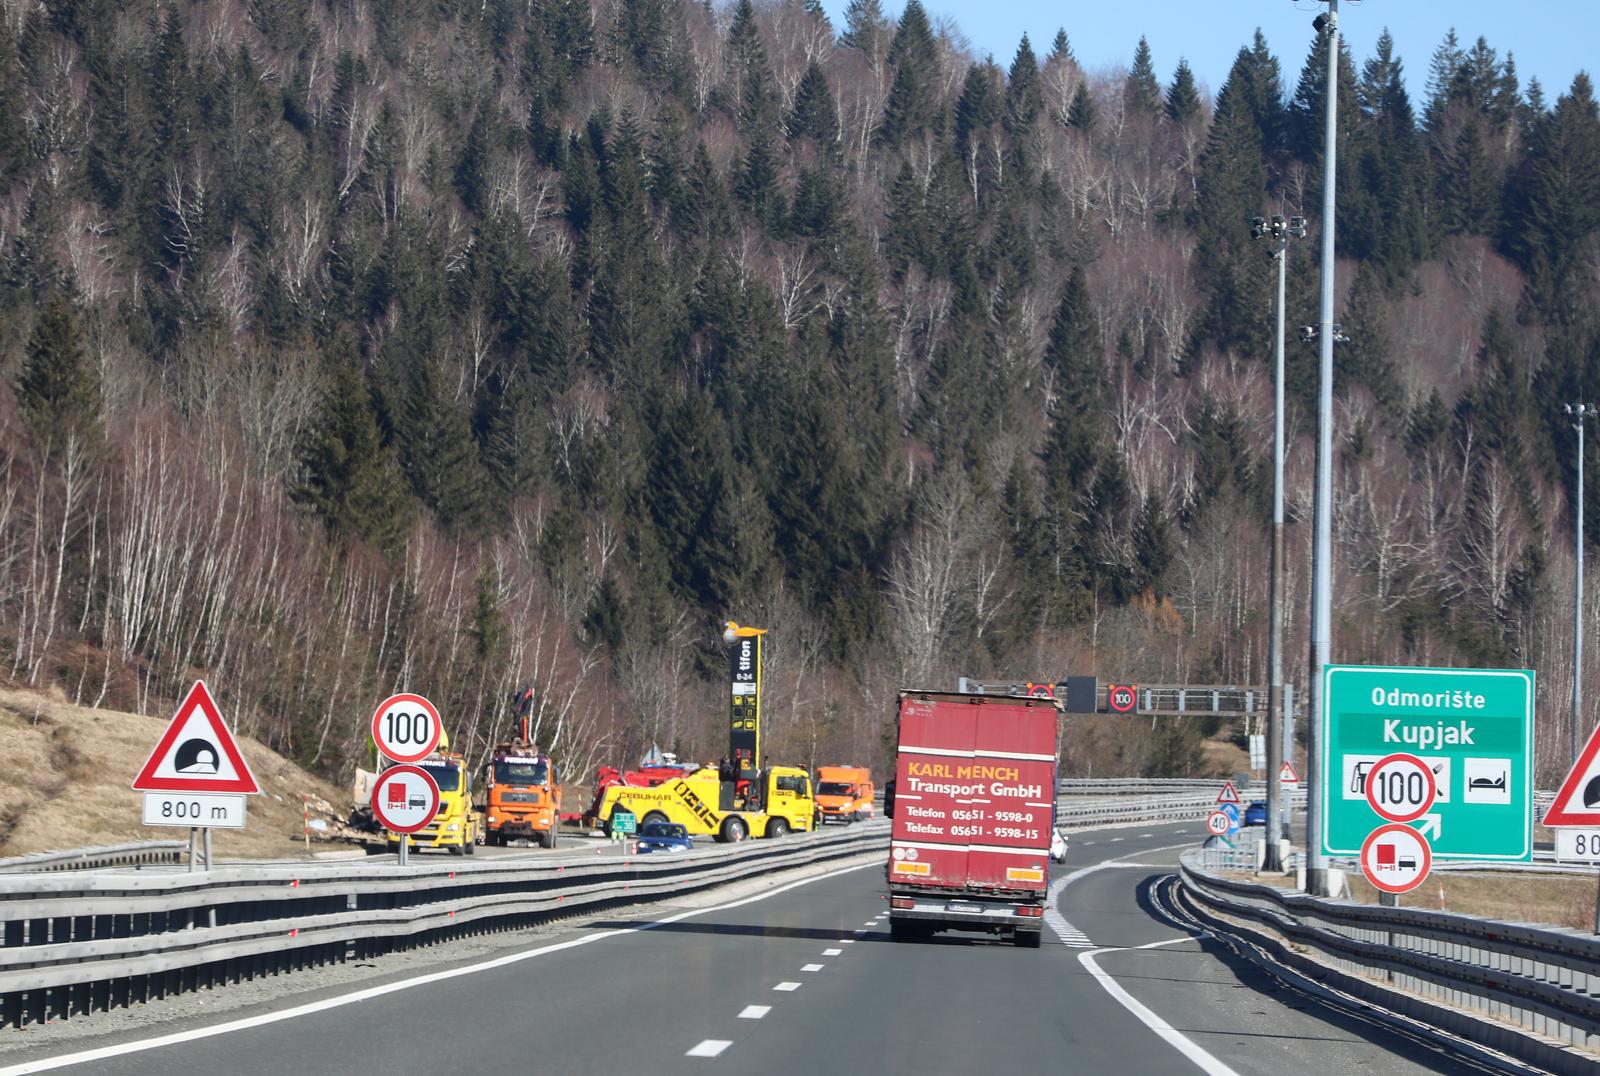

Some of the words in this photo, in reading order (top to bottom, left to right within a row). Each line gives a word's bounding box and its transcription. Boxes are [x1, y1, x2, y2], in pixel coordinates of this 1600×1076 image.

[739, 640, 751, 670] tifon
[1115, 693, 1131, 704] 100
[1371, 687, 1486, 709] Odmorište
[386, 712, 429, 745] 100
[1383, 718, 1475, 750] Kupjak
[908, 762, 953, 778] KARL
[957, 765, 1019, 781] MENCH
[907, 778, 985, 798] Transport
[990, 783, 1042, 798] GmbH
[1378, 771, 1423, 805] 100
[162, 801, 201, 818] 800
[211, 807, 227, 819] m
[906, 806, 945, 819] Telefon
[952, 809, 984, 820] 05651
[995, 811, 1033, 823] 9598-0
[905, 822, 944, 834] Telefax
[951, 825, 983, 836] 05651
[994, 827, 1038, 839] 9598-15
[1212, 817, 1226, 830] 40
